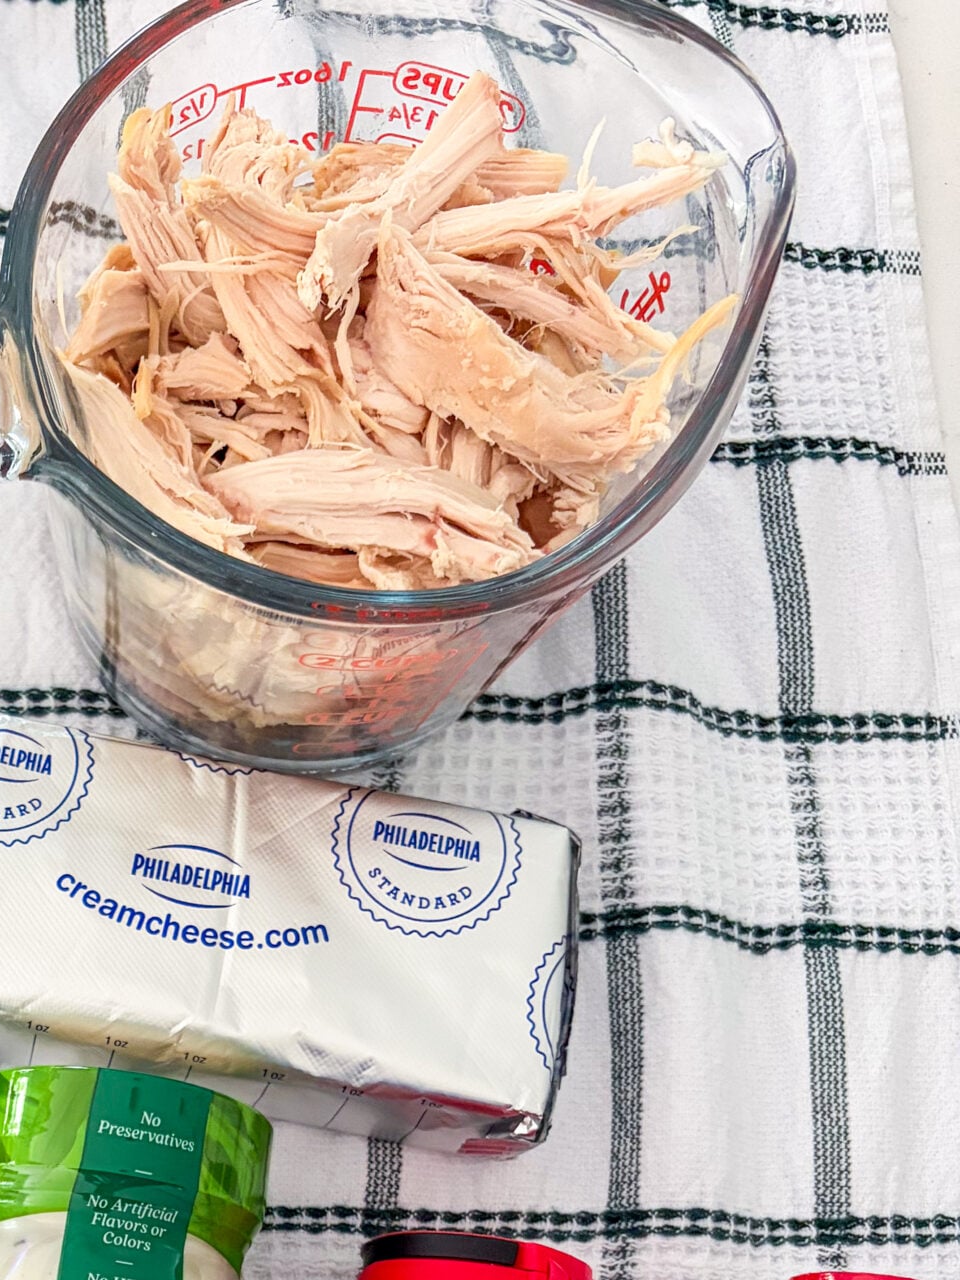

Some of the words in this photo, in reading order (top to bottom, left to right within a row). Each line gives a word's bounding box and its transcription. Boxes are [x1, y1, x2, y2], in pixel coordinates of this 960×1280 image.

[372, 820, 481, 862] PHILADELPHIA
[131, 853, 251, 899] PHILADELPHIA
[368, 866, 473, 910] STANDARD
[55, 872, 330, 950] creamcheese.com
[139, 1110, 162, 1127] No
[97, 1119, 195, 1152] Preservatives
[86, 1195, 108, 1209] No
[110, 1198, 179, 1225] Artificial
[91, 1212, 148, 1235] Flavors
[150, 1224, 167, 1238] or
[102, 1231, 152, 1251] Colors
